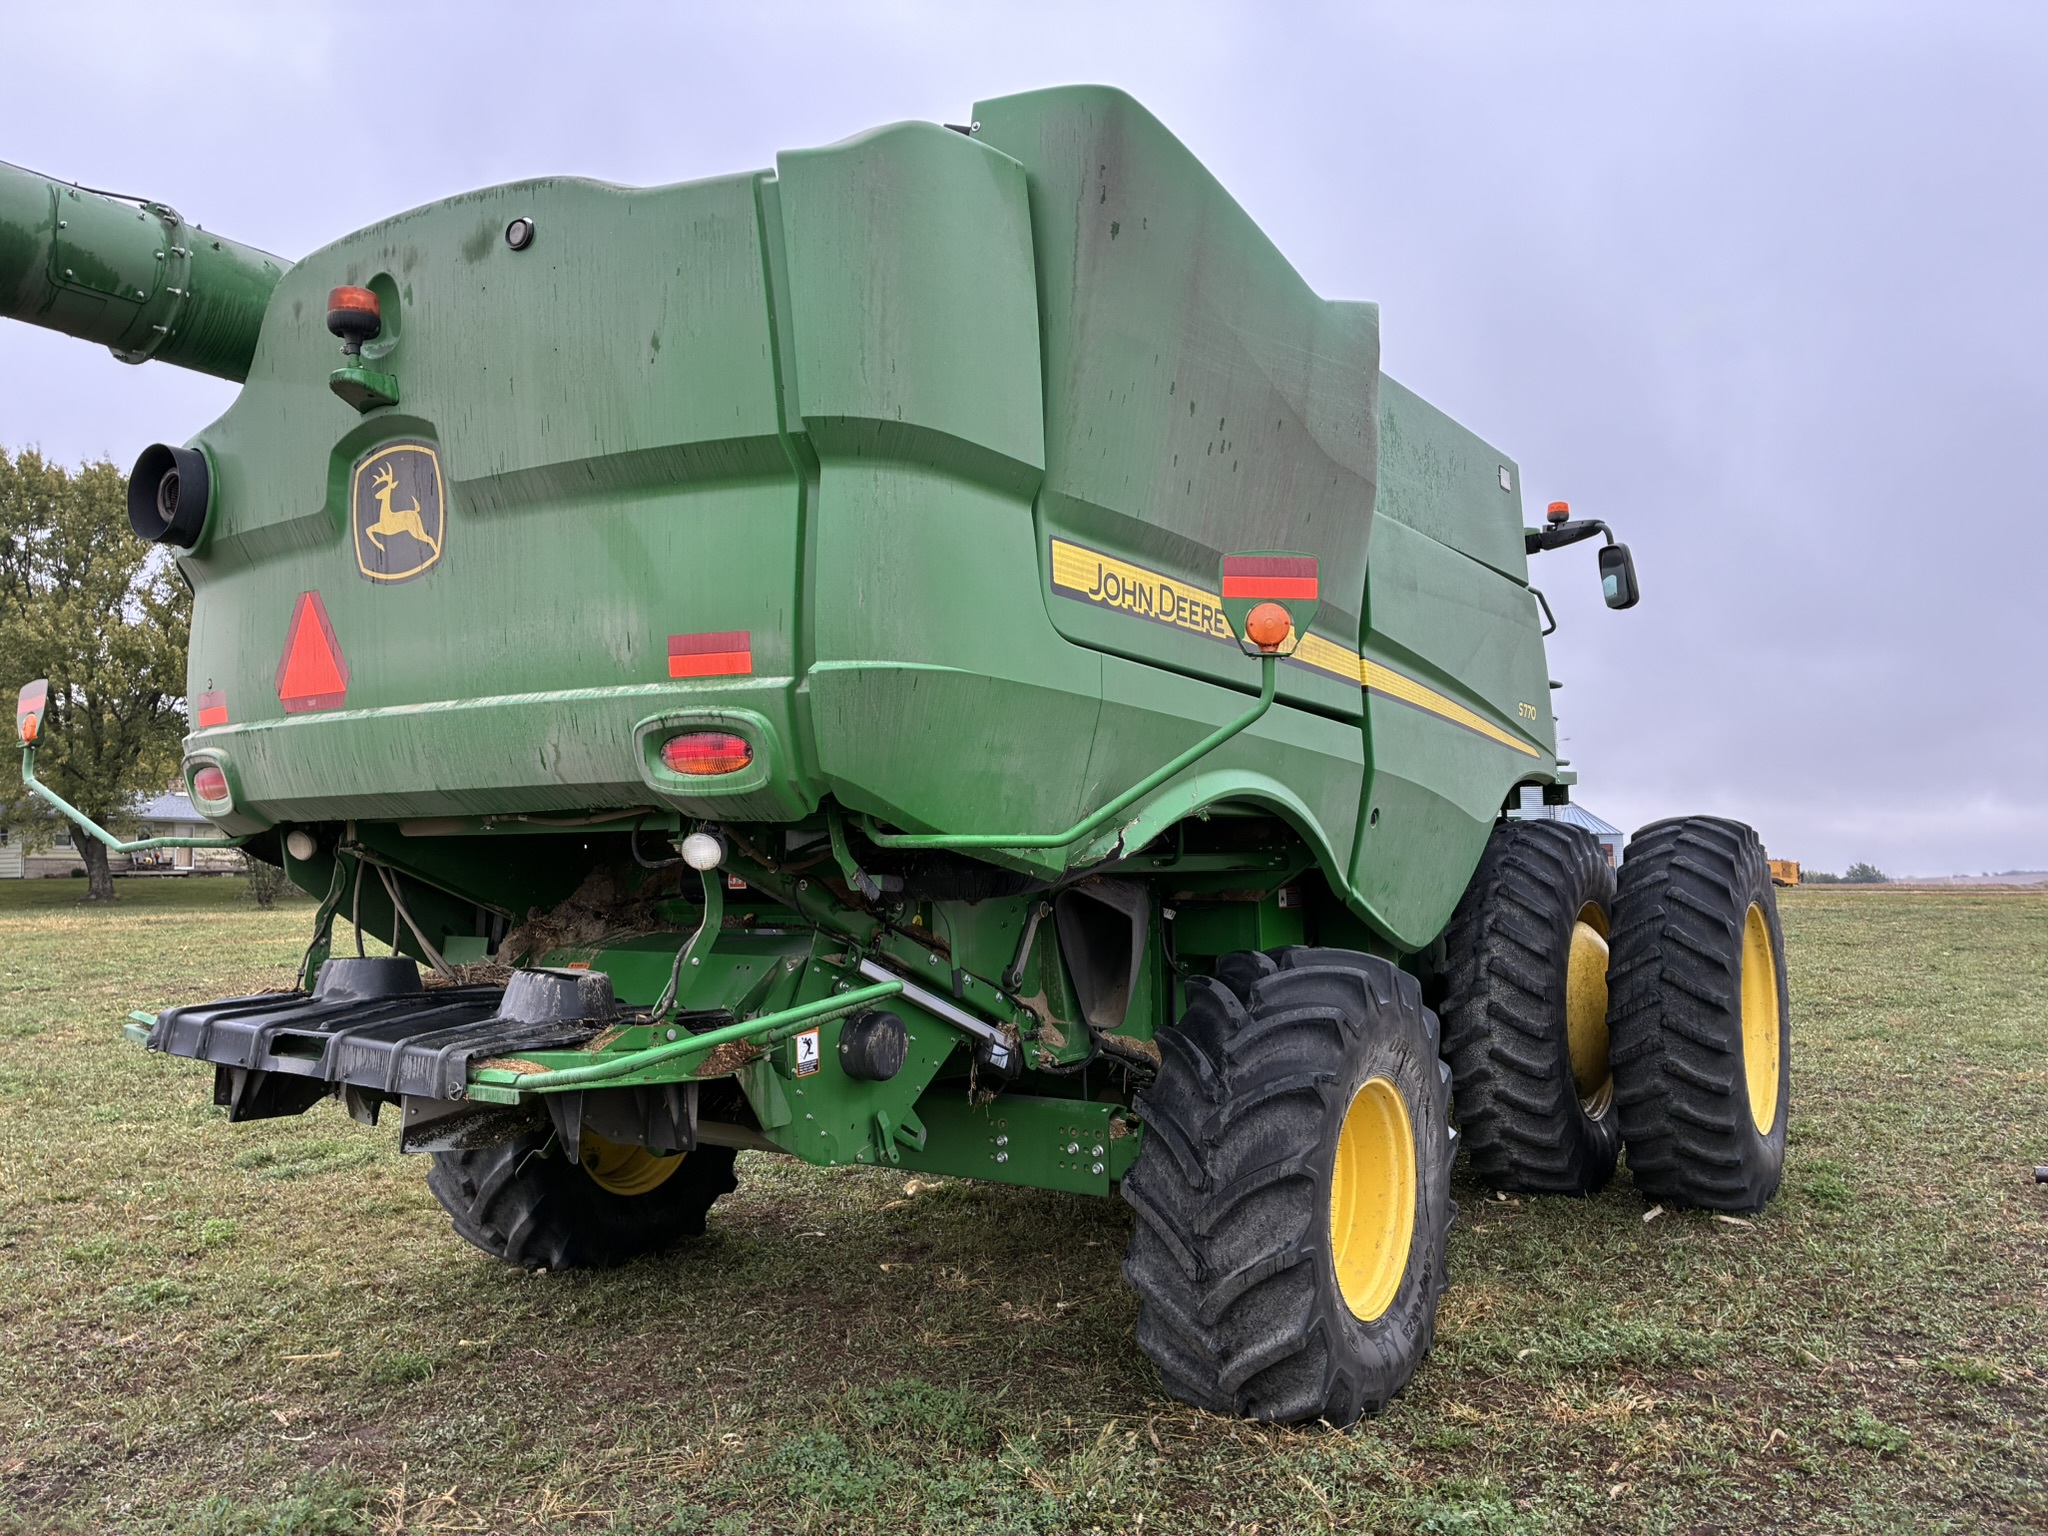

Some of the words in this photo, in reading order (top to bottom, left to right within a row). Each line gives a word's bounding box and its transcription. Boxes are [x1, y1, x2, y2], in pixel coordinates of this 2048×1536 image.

[1088, 562, 1153, 614] JOHN
[1159, 583, 1225, 634] DEERE
[1518, 701, 1537, 721] S770
